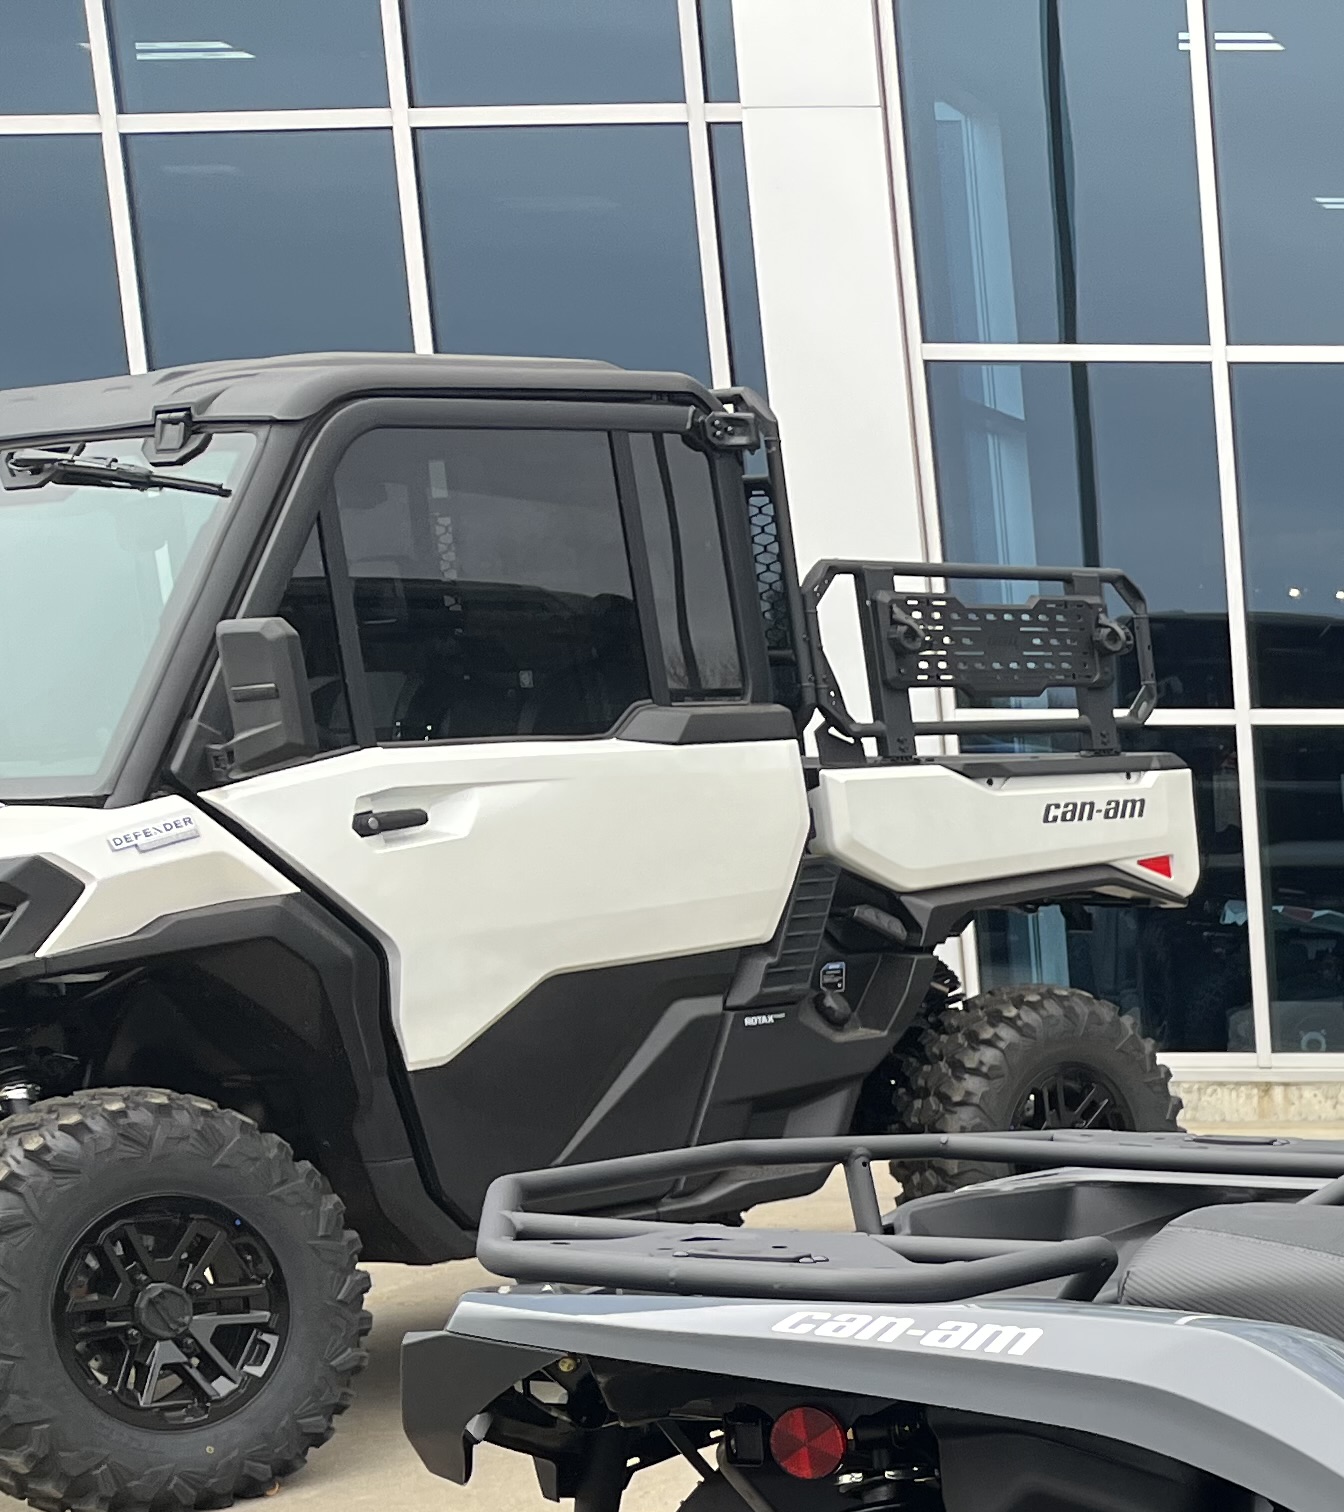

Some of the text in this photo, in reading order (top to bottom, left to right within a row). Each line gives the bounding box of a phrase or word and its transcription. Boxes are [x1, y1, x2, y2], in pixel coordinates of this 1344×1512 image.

[1043, 798, 1146, 824] can-am
[744, 1014, 774, 1027] ROTAX
[771, 1311, 1044, 1356] can-am
